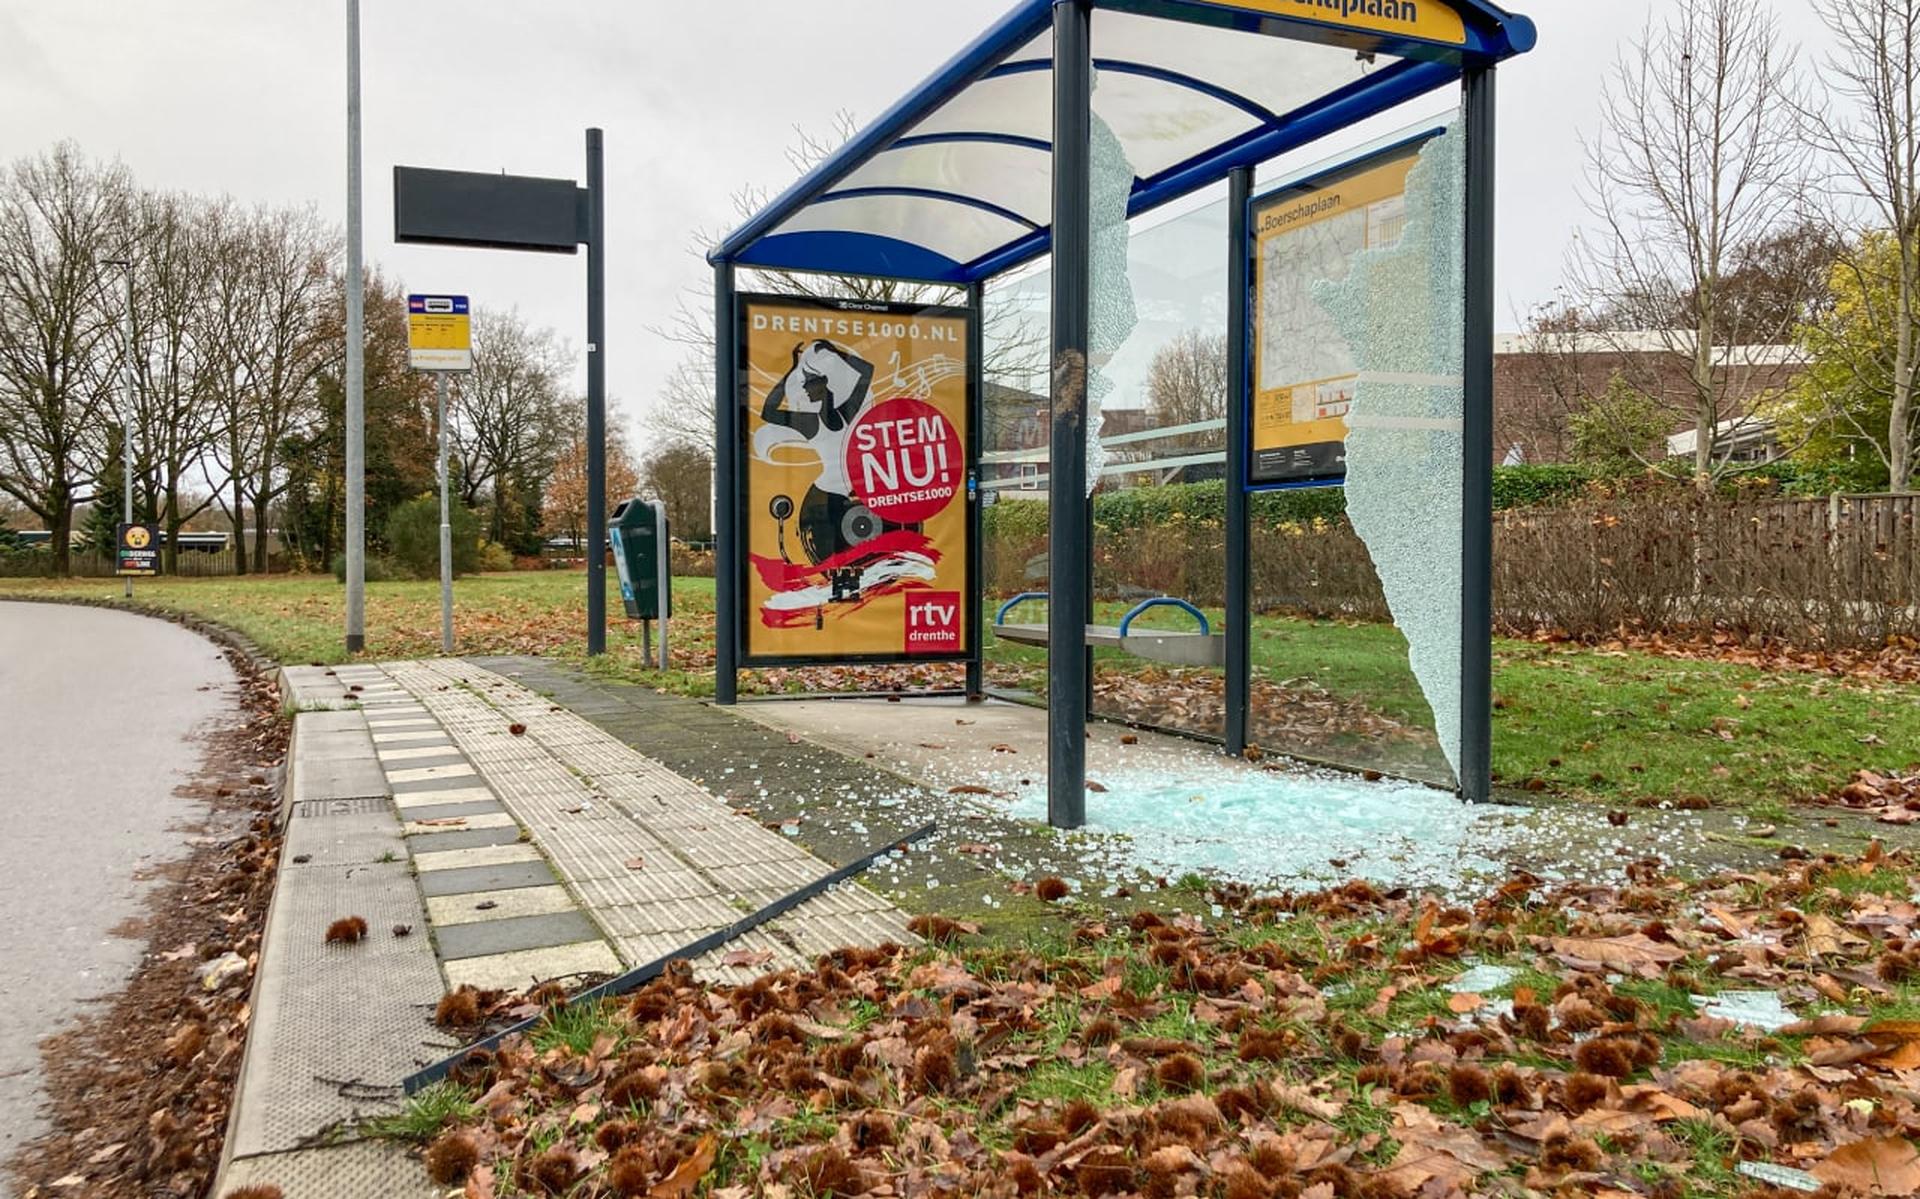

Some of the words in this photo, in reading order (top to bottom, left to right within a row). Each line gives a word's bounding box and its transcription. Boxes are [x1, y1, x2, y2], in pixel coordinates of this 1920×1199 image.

[1294, 0, 1417, 23] plaan
[1264, 194, 1341, 231] Boerschaplaan
[752, 314, 959, 342] DRENTSE1000.NL
[855, 415, 947, 451] STEM
[861, 443, 950, 494] NU!
[867, 487, 952, 508] DRENTSE1000
[909, 602, 955, 627] rtv
[909, 629, 956, 642] drenthe
